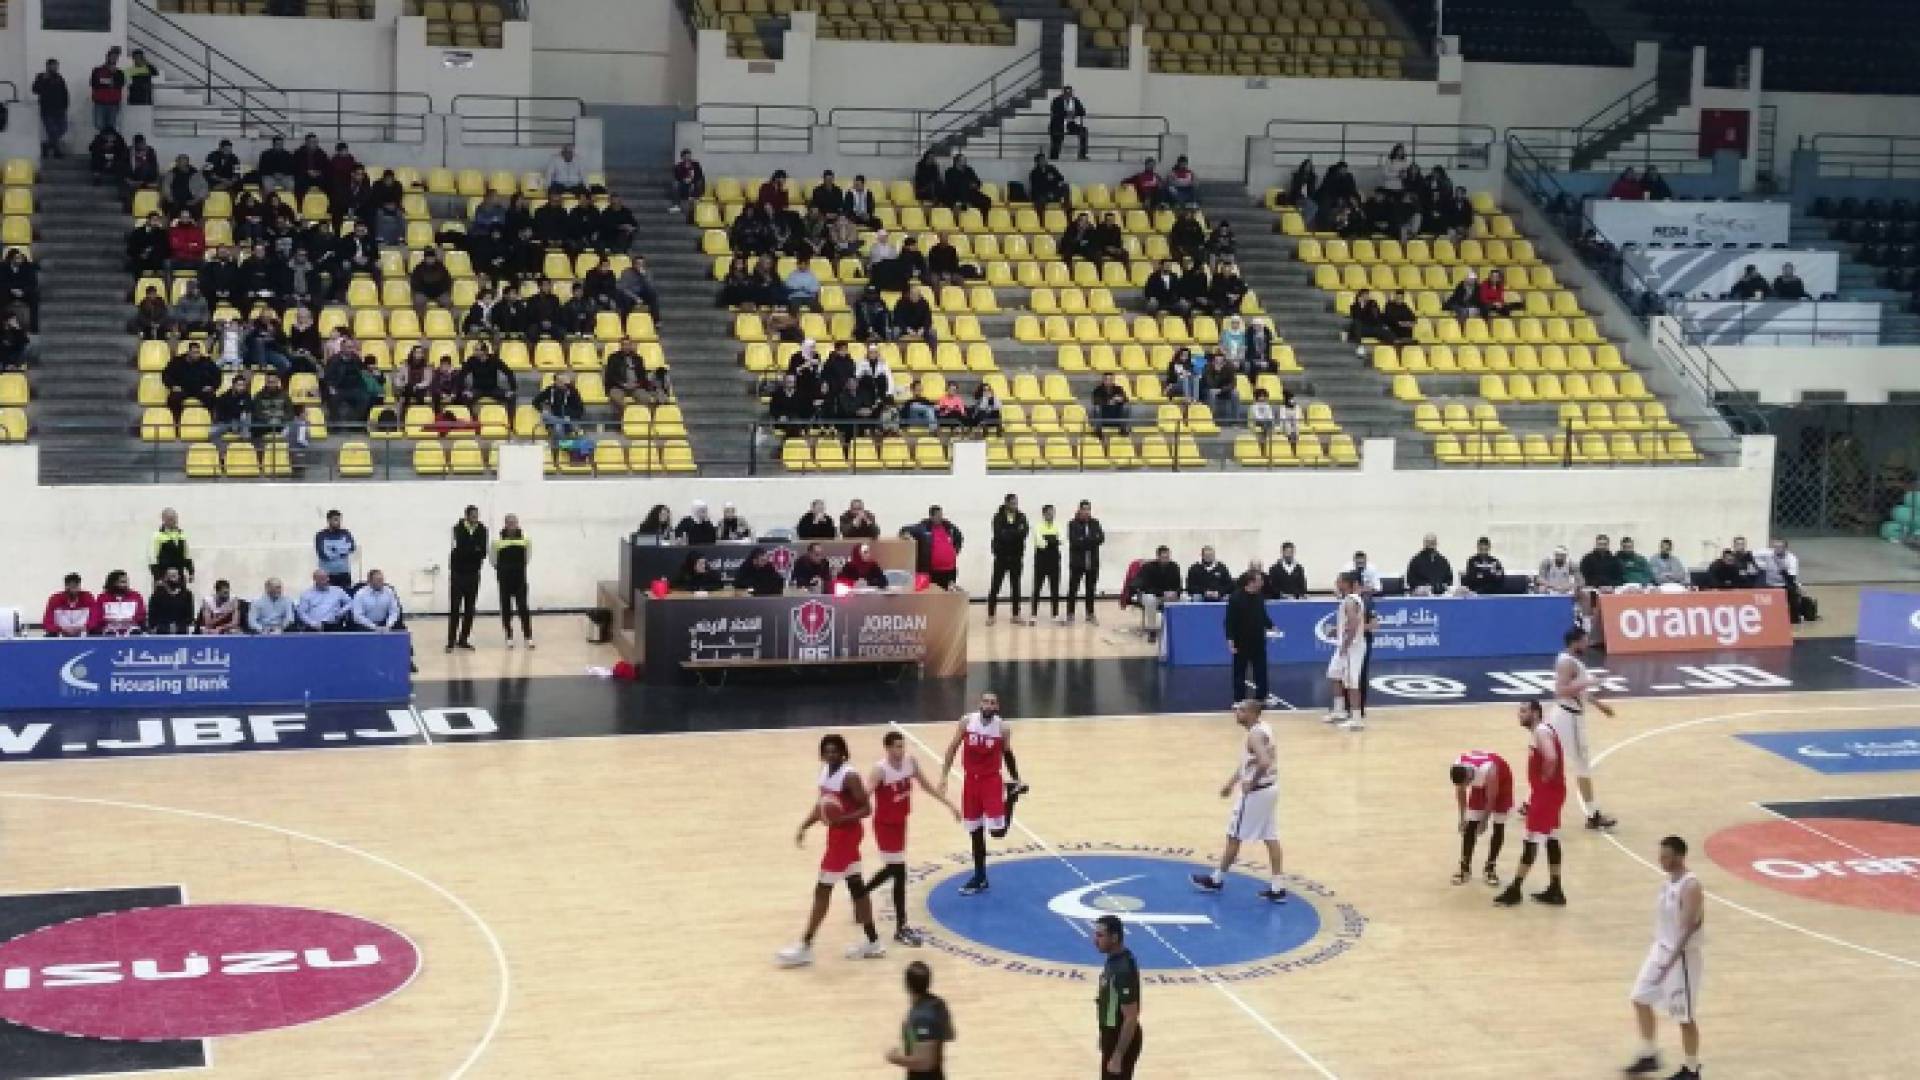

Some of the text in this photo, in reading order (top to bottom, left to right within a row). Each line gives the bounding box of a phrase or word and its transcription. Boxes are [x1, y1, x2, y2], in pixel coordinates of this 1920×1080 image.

[860, 615, 927, 632] JORDAN
[1619, 604, 1763, 645] orange
[1407, 632, 1440, 646] Bank
[110, 675, 231, 695] Housing Bank
